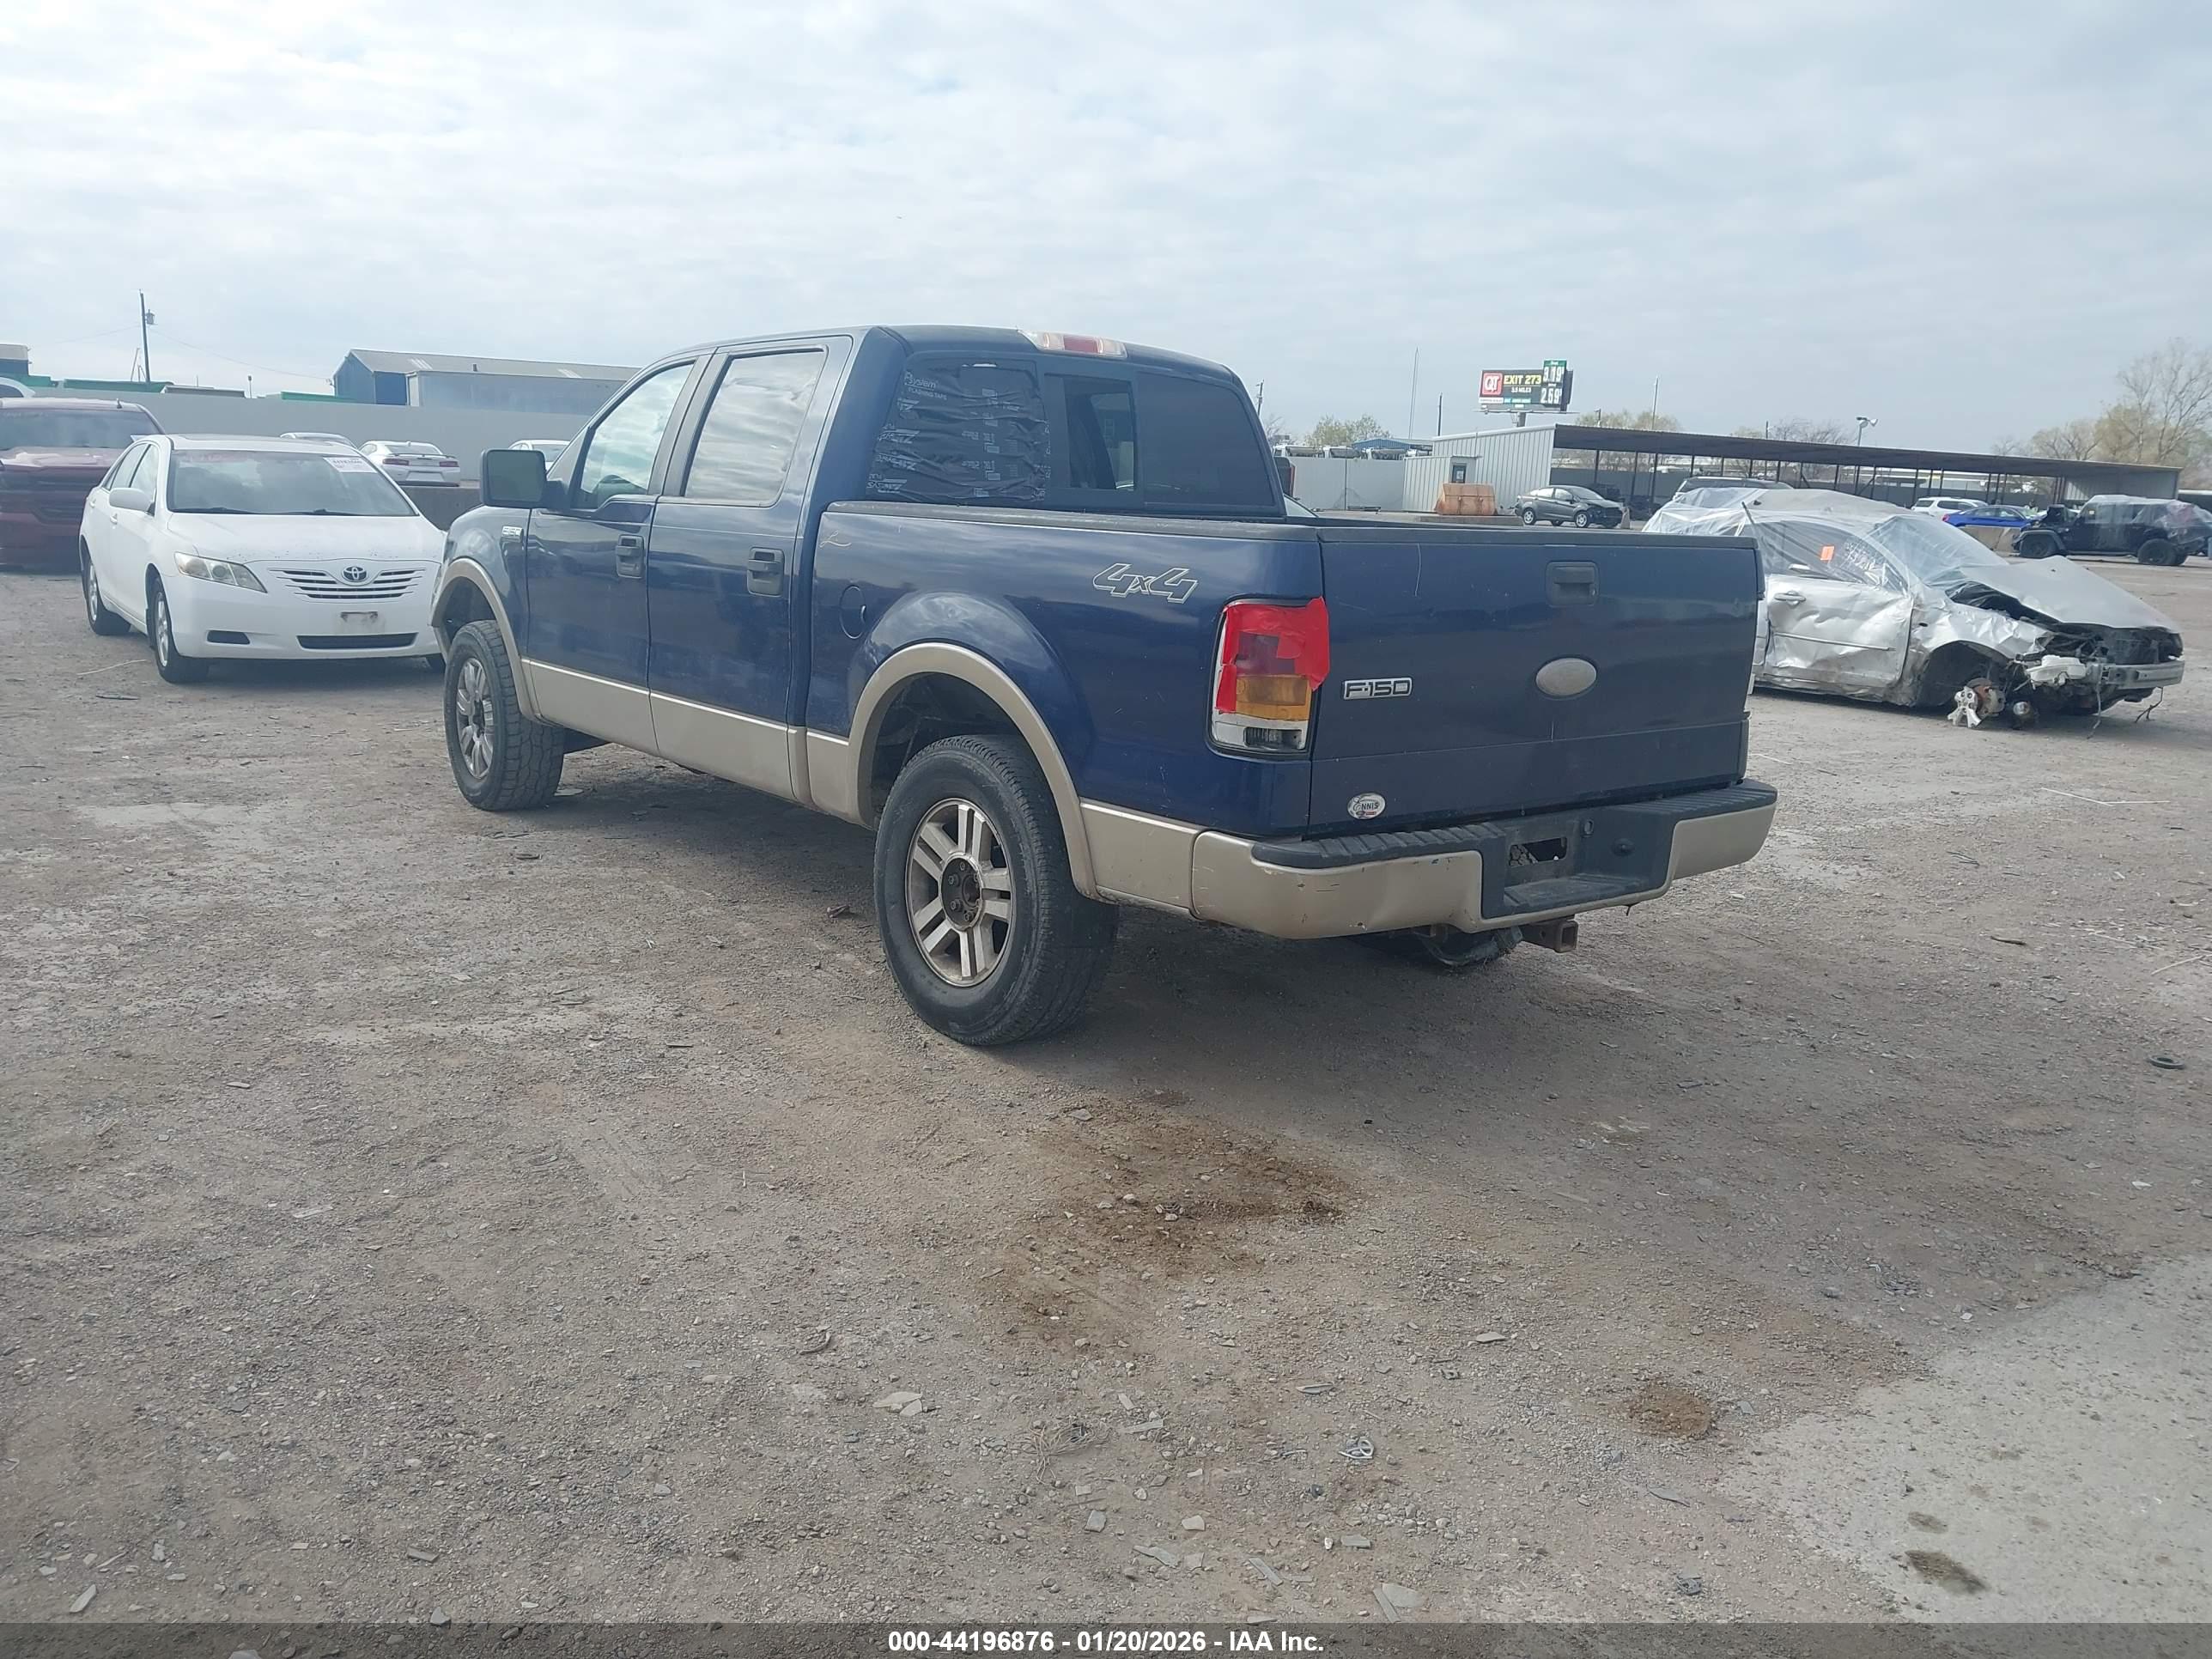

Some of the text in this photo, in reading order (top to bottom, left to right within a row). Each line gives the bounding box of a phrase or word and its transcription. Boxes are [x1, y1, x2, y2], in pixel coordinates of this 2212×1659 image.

[1485, 375, 1499, 392] QT
[1504, 374, 1541, 385] EXIT 273
[1092, 562, 1199, 604] 4x4
